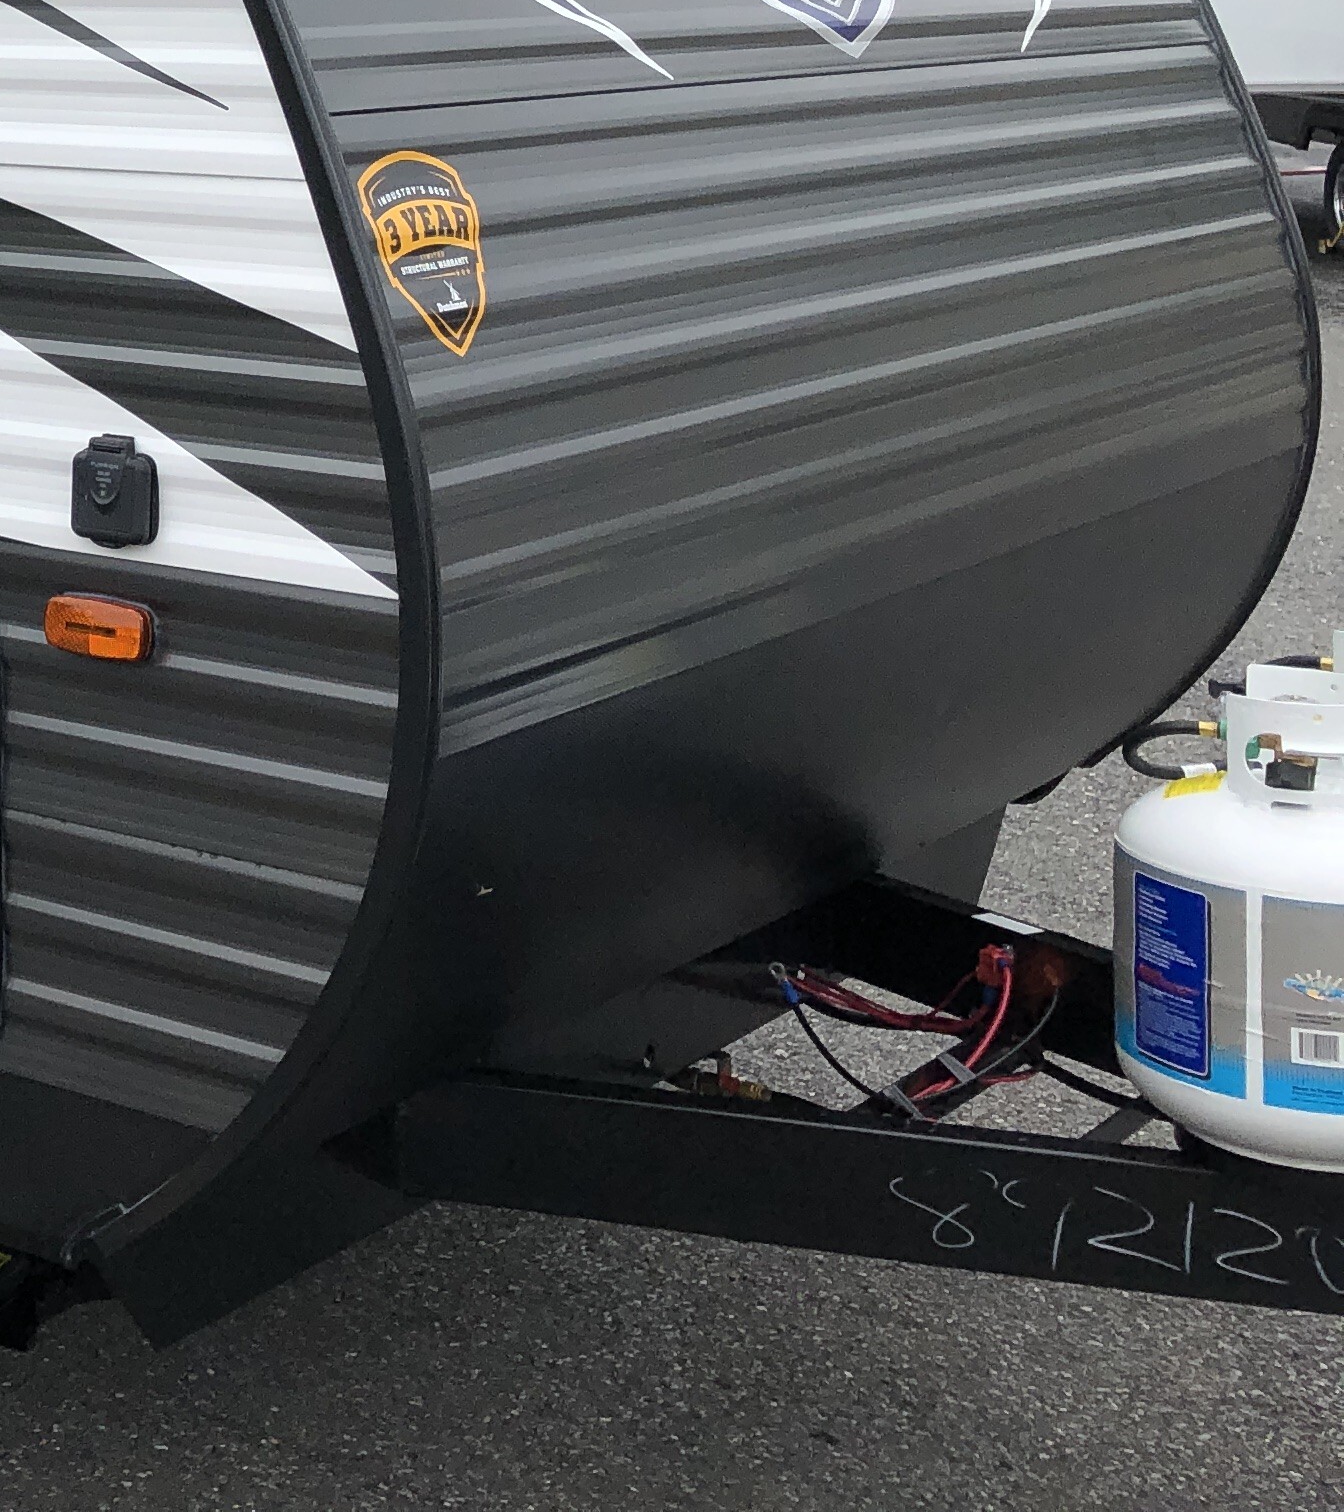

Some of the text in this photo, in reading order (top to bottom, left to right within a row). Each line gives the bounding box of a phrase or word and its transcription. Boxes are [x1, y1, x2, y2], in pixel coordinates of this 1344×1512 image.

[428, 185, 451, 199] BEST
[383, 203, 470, 255] 3 YEAR
